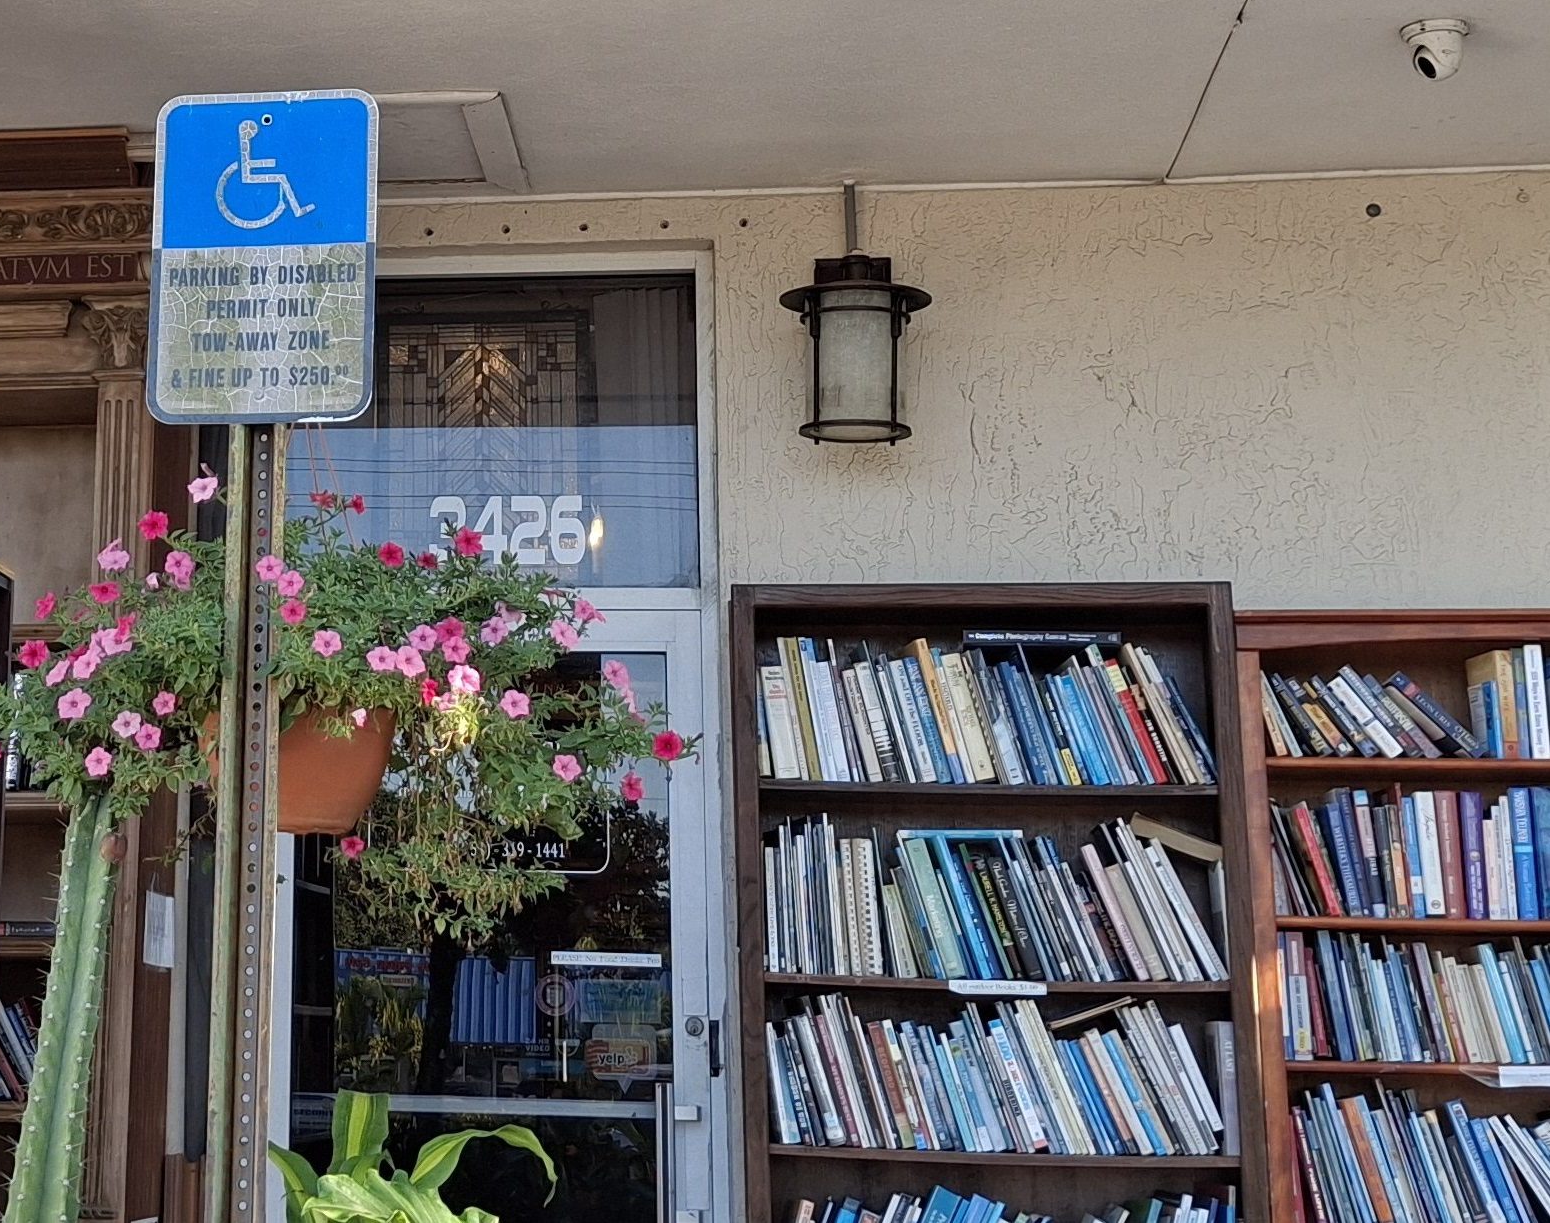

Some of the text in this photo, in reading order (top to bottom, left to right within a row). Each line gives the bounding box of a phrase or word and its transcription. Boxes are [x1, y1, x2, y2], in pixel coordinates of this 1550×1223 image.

[86, 253, 132, 278] EST
[169, 263, 357, 288] PARKING BY DISABLED
[206, 297, 316, 320] PERMIT ONLY
[192, 330, 330, 353] TOW-AWAY ZONE
[171, 368, 182, 389] &
[188, 368, 225, 389] FINE
[231, 367, 254, 388] UP
[259, 366, 279, 387] TO
[429, 494, 586, 565] 3426
[1414, 693, 1435, 713] LEON
[1432, 710, 1451, 728] URIS
[1342, 863, 1360, 906] THESAURUS
[925, 894, 945, 938] Marketing
[598, 1052, 625, 1065] yelp
[959, 1034, 976, 1068] THE NEW
[998, 1039, 1013, 1060] 100
